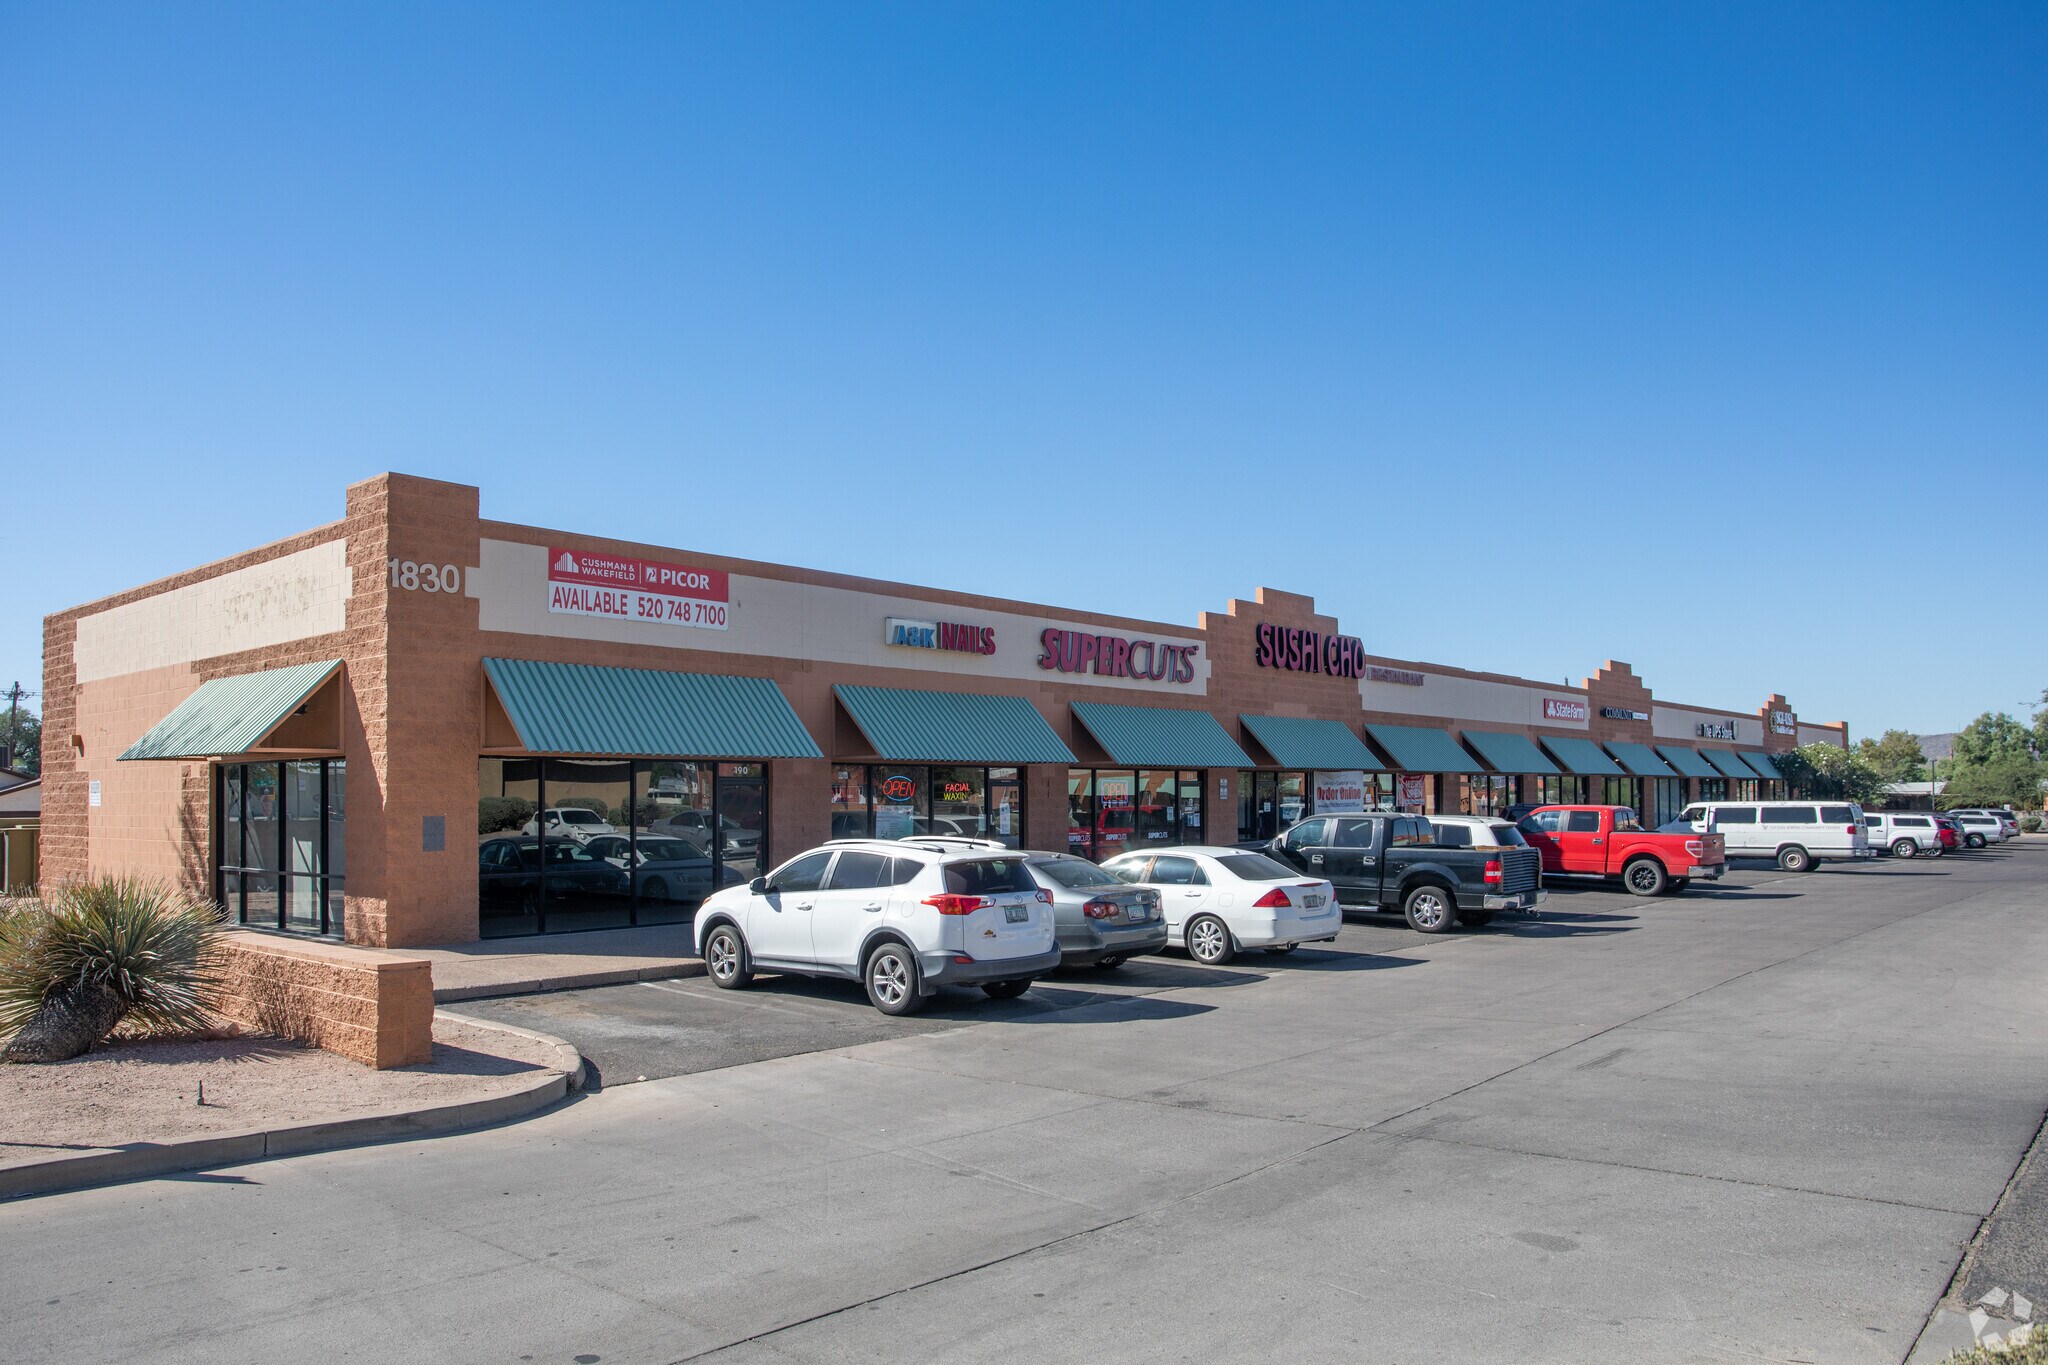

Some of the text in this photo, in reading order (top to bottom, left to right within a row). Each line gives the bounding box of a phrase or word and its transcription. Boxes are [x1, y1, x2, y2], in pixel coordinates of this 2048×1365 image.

[581, 557, 635, 572] CUSHMAN &
[581, 566, 636, 581] WAKEFIELD
[387, 557, 460, 594] 1830
[660, 568, 710, 590] PICOR
[551, 585, 726, 625] AVAILABLE 520 748 7100
[895, 622, 996, 655] A&K NAILS
[1038, 628, 1199, 684] SUPERCUTS
[1256, 623, 1367, 679] SUSHI CHO
[1371, 667, 1426, 687] RESTAURANT
[1703, 724, 1733, 739] The UPS Store
[734, 766, 748, 775] 190
[883, 780, 916, 797] OPEN
[945, 783, 970, 792] FACIAL
[1103, 783, 1127, 801] OPEN
[1316, 786, 1361, 800] Order Online
